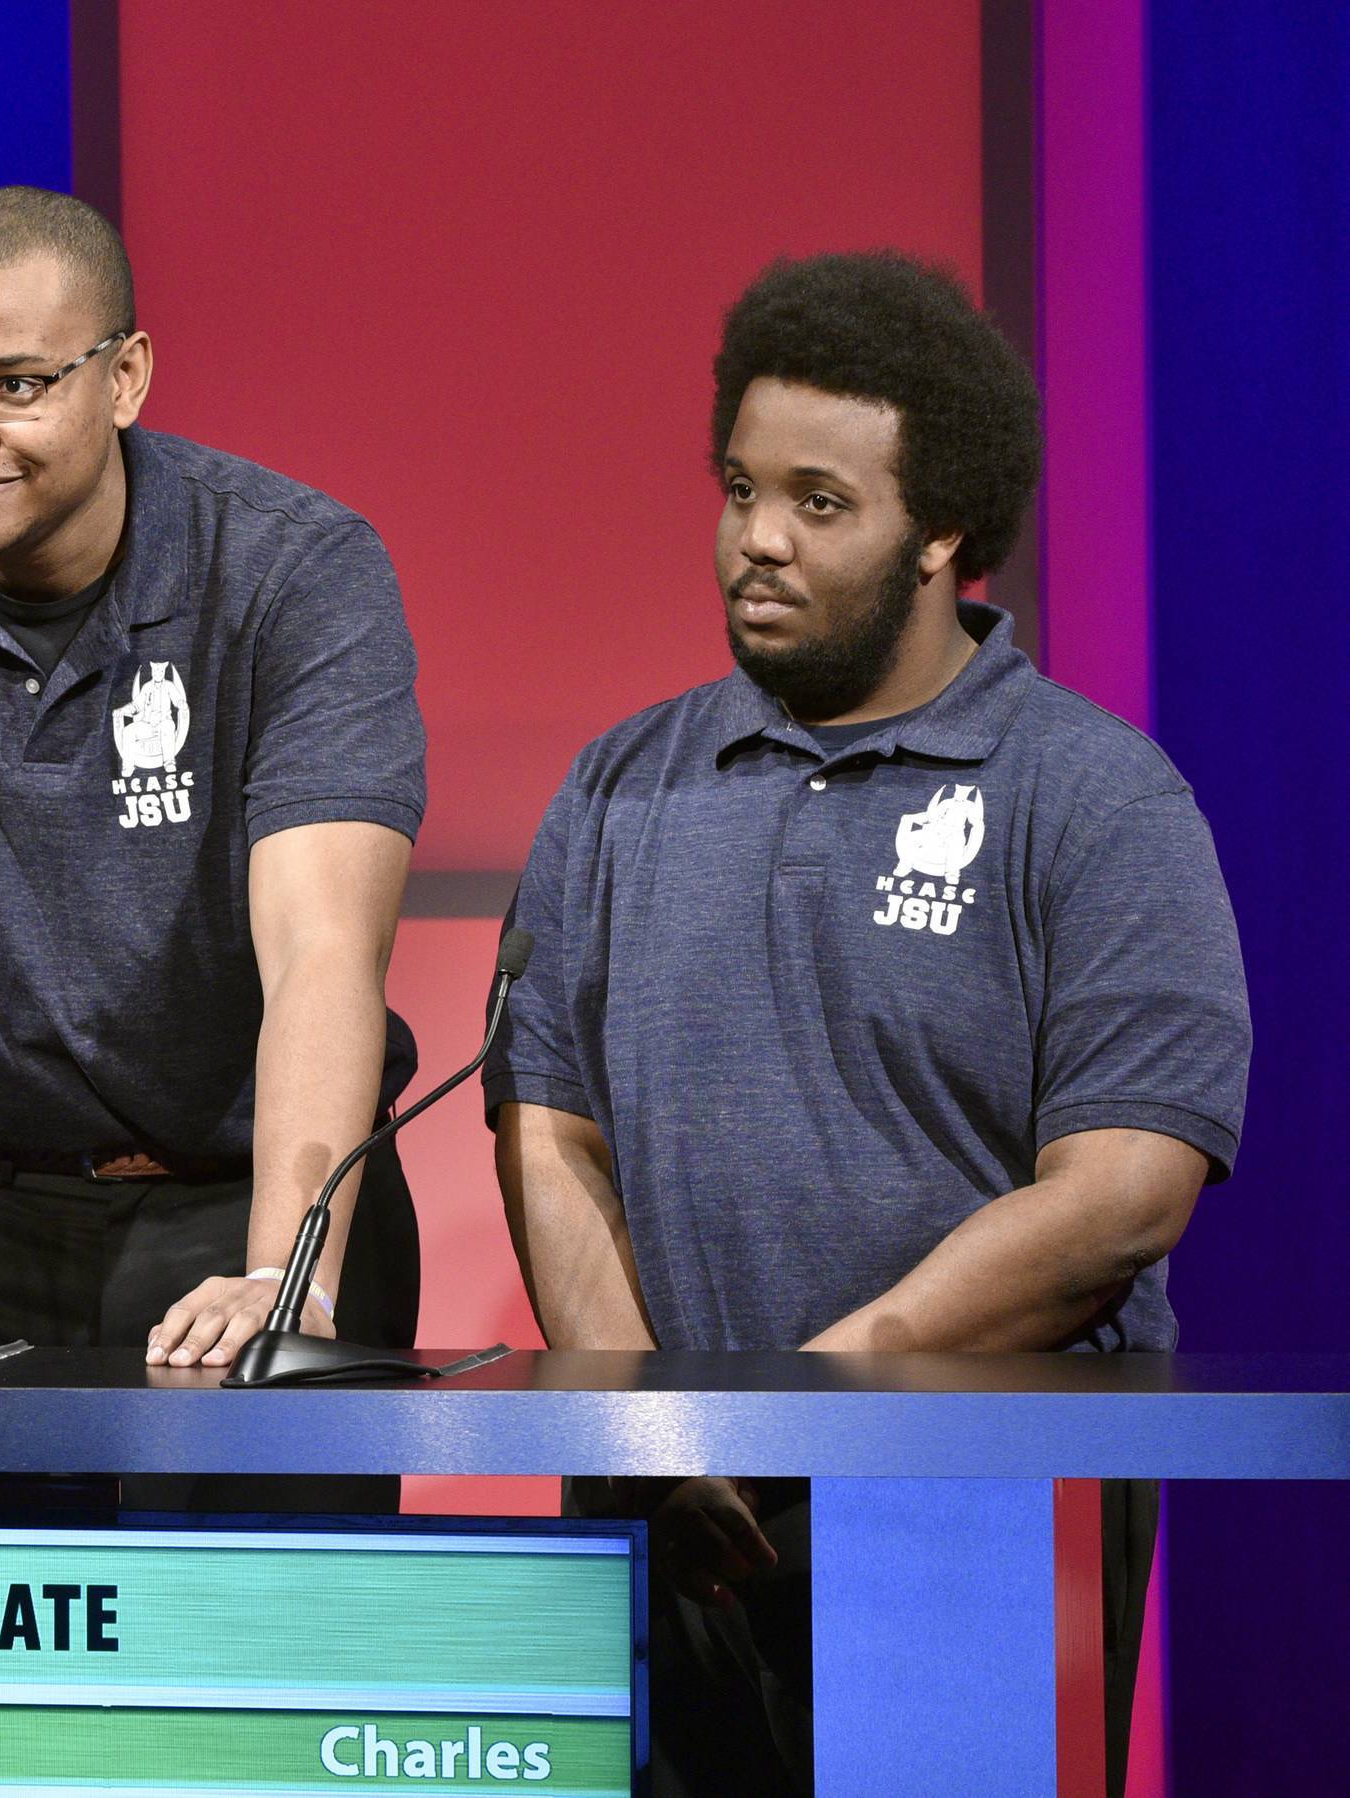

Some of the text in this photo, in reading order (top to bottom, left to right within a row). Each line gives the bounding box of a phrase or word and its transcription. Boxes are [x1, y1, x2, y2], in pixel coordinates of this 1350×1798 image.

[112, 772, 195, 795] HCASC
[119, 789, 192, 828] JSU
[875, 875, 977, 904] HCASC
[873, 894, 963, 935] JSU
[319, 1723, 552, 1781] Charles
